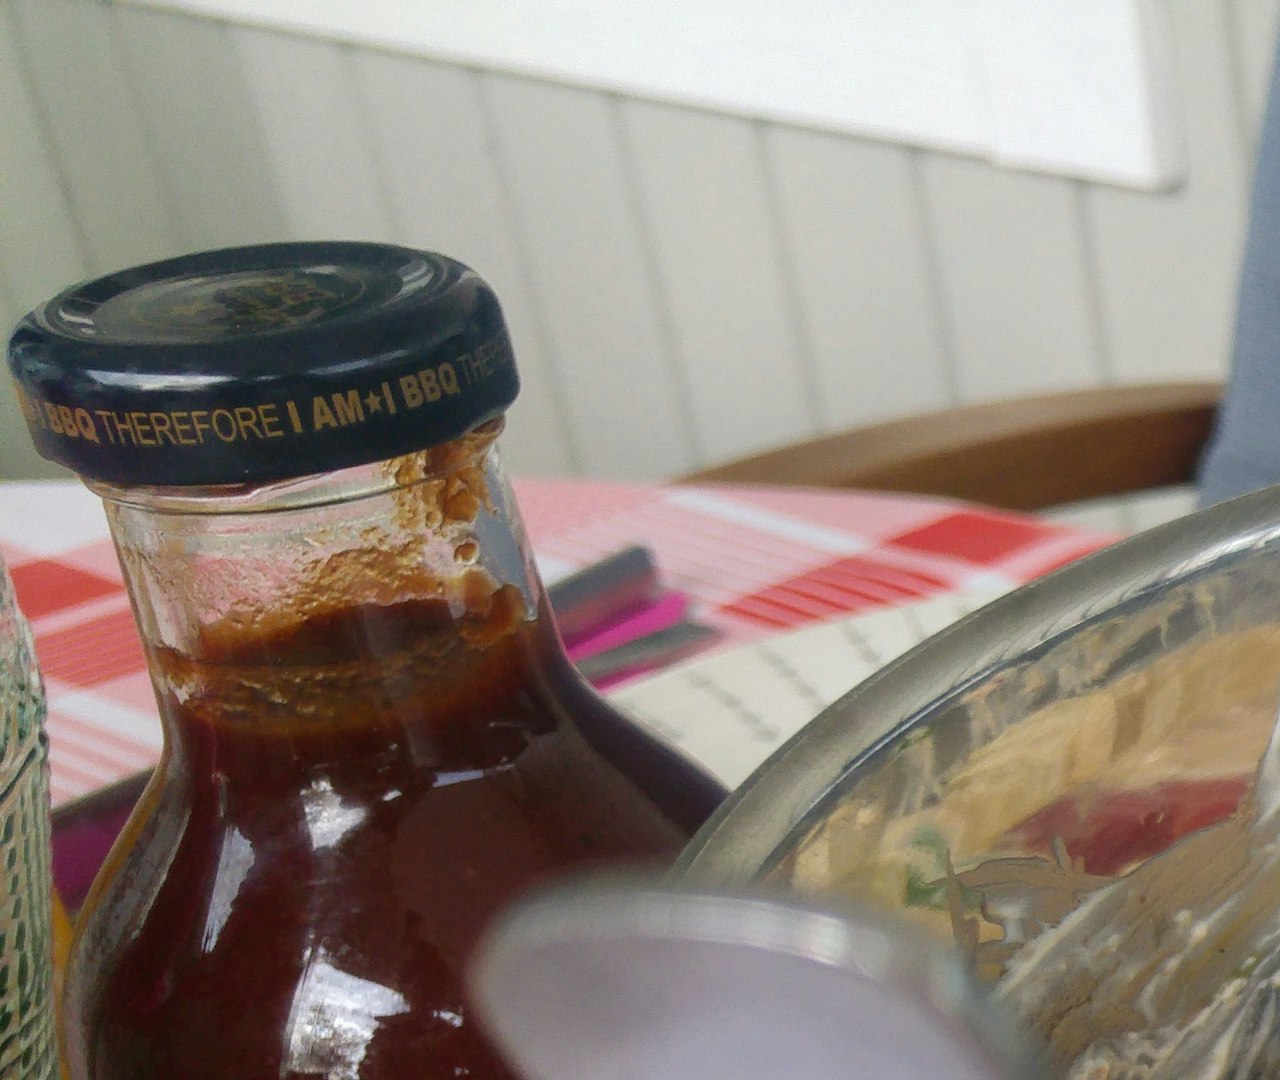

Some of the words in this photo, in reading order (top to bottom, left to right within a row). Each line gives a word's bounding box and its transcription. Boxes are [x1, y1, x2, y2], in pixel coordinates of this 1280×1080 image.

[45, 402, 100, 443] BBQ
[95, 403, 285, 447] THEREFORE
[286, 400, 304, 434] I
[312, 389, 366, 431] AM
[382, 381, 397, 414] I
[400, 361, 461, 410] BBQ
